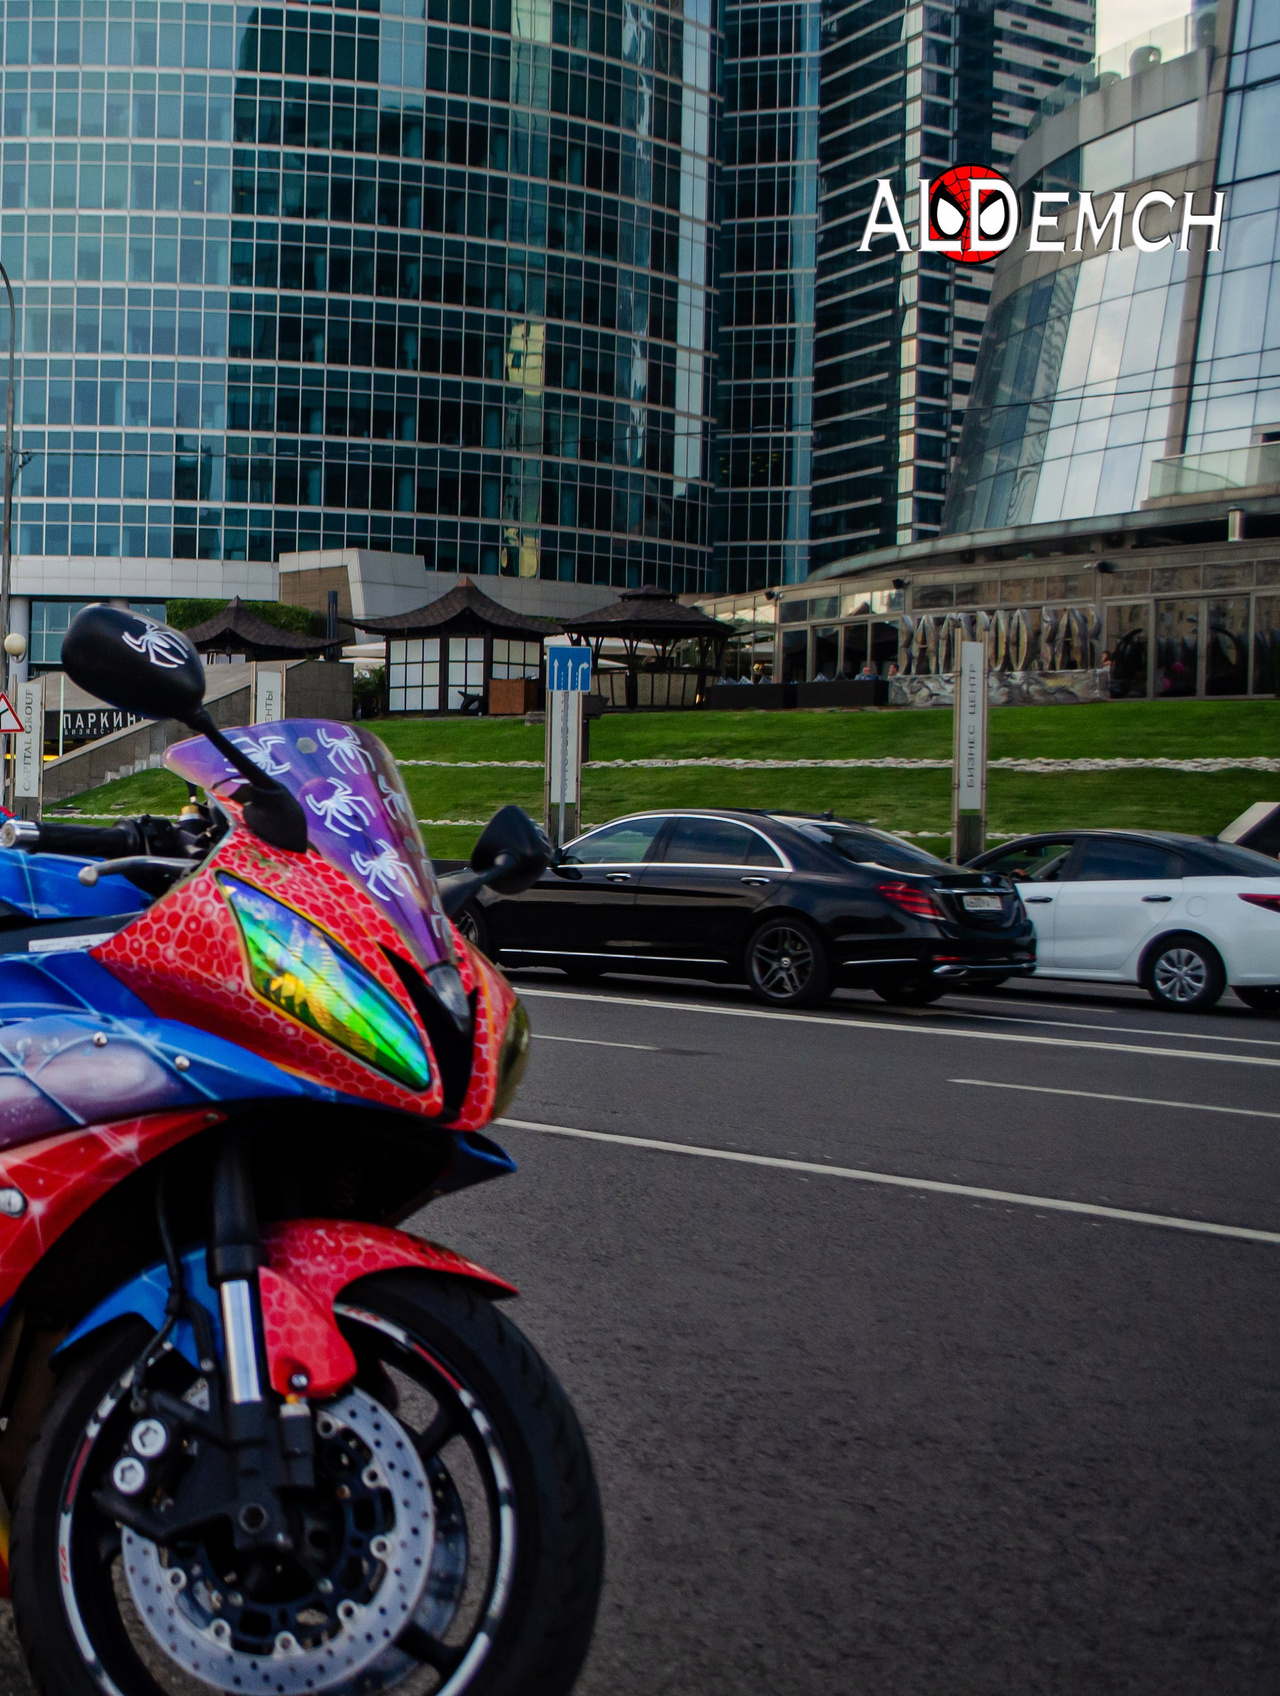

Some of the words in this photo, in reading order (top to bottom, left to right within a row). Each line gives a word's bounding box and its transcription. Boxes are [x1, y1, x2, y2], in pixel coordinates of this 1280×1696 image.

[24, 689, 33, 734] GROUP
[63, 711, 144, 729] ПАРКИН
[23, 738, 33, 791] CAPITAL
[966, 725, 975, 788] БИЗНЕС
